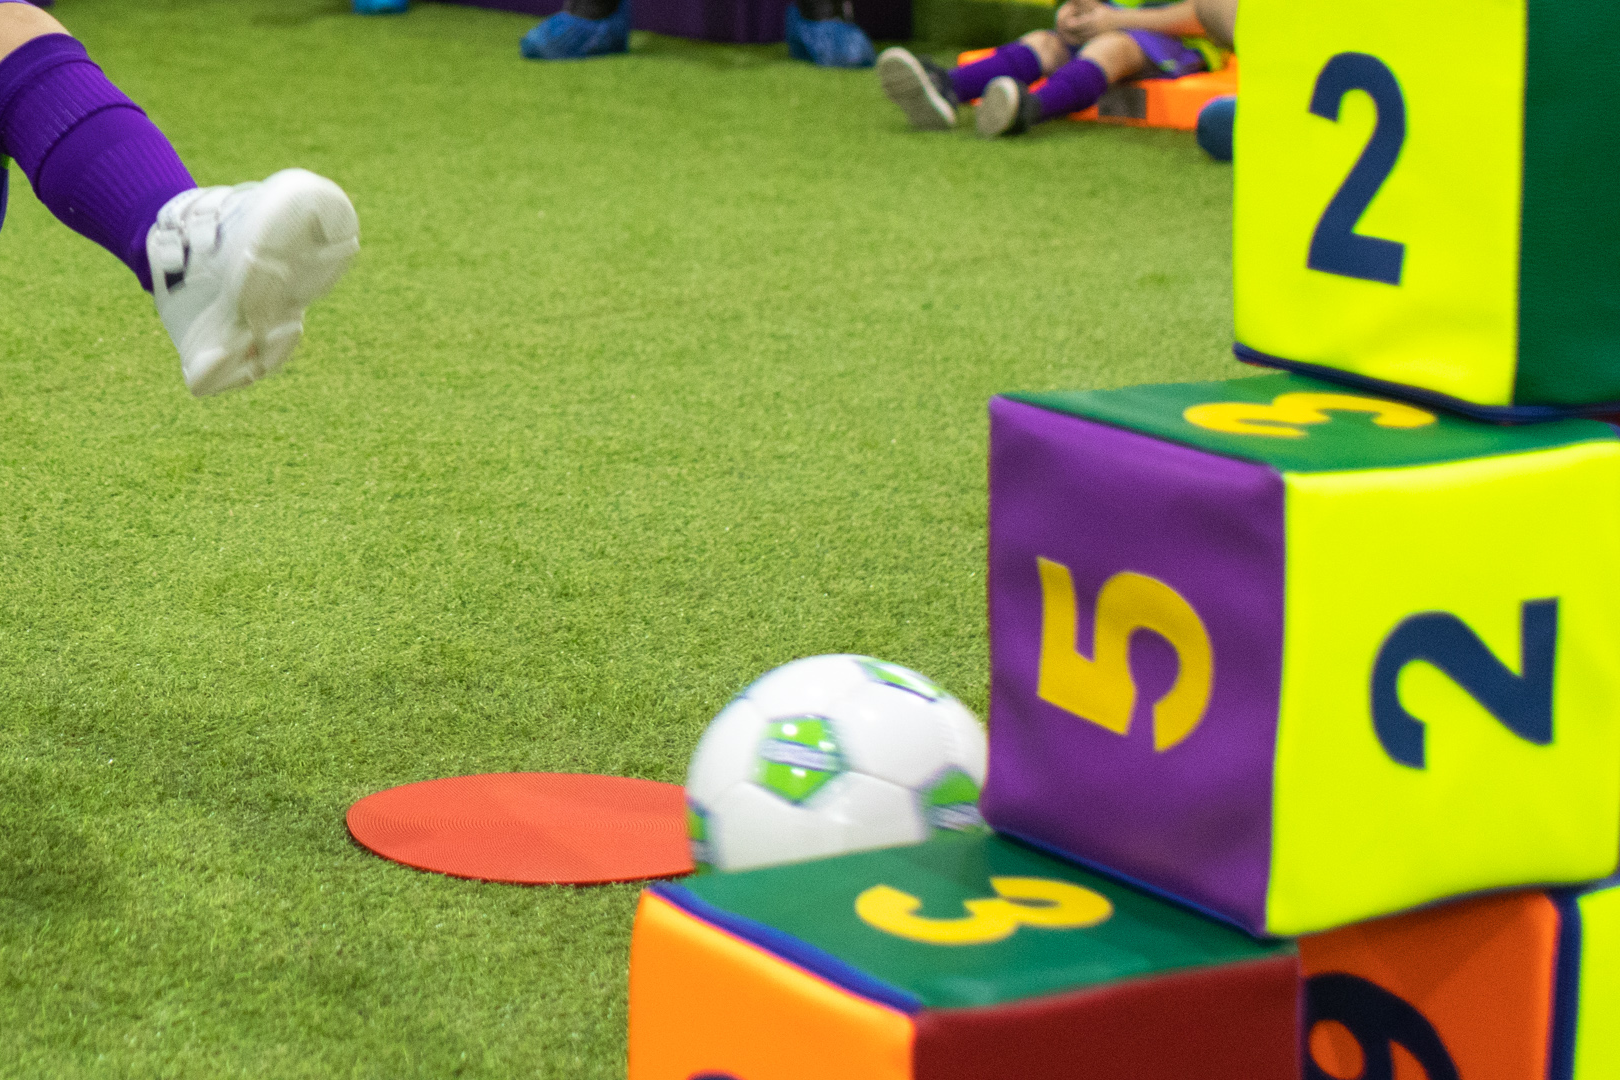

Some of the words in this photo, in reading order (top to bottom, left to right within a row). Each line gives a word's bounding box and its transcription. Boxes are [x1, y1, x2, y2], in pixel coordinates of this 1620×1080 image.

[1307, 51, 1407, 286] 2
[1036, 556, 1214, 752] 5
[1370, 596, 1560, 771] 2
[855, 876, 1113, 945] 3
